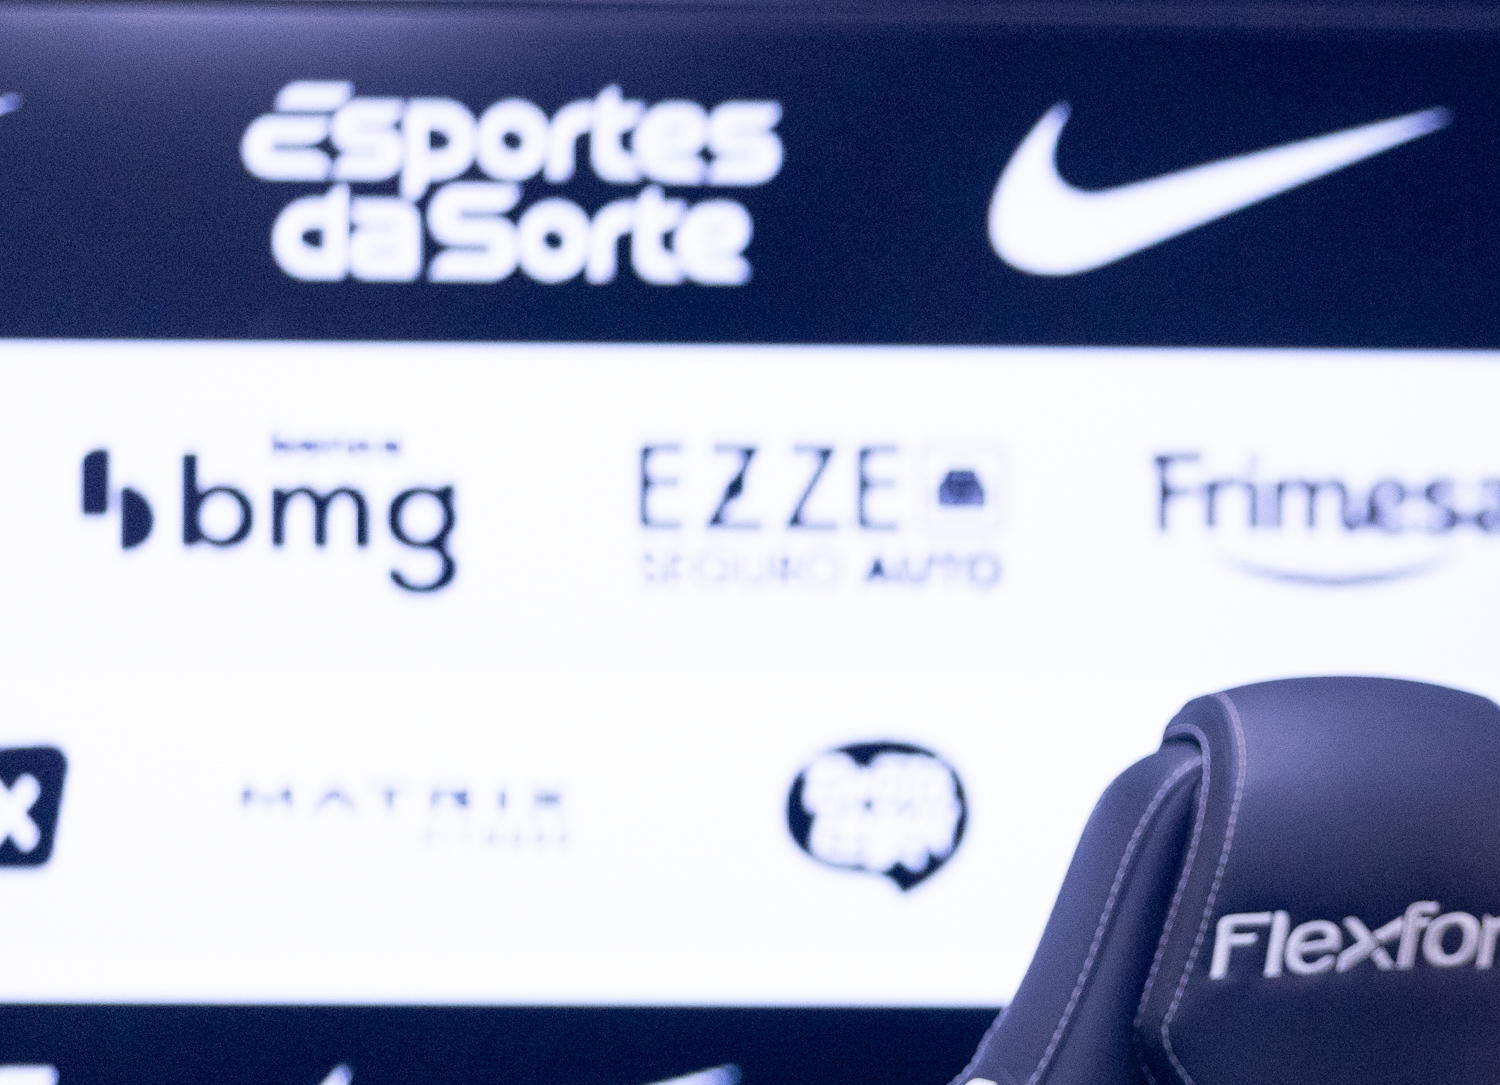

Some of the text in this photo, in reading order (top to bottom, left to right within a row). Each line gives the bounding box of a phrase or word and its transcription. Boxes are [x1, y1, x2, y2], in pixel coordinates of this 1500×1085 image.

[242, 81, 783, 201] Esportes
[182, 453, 458, 594] bmg
[638, 444, 901, 532] EZZE
